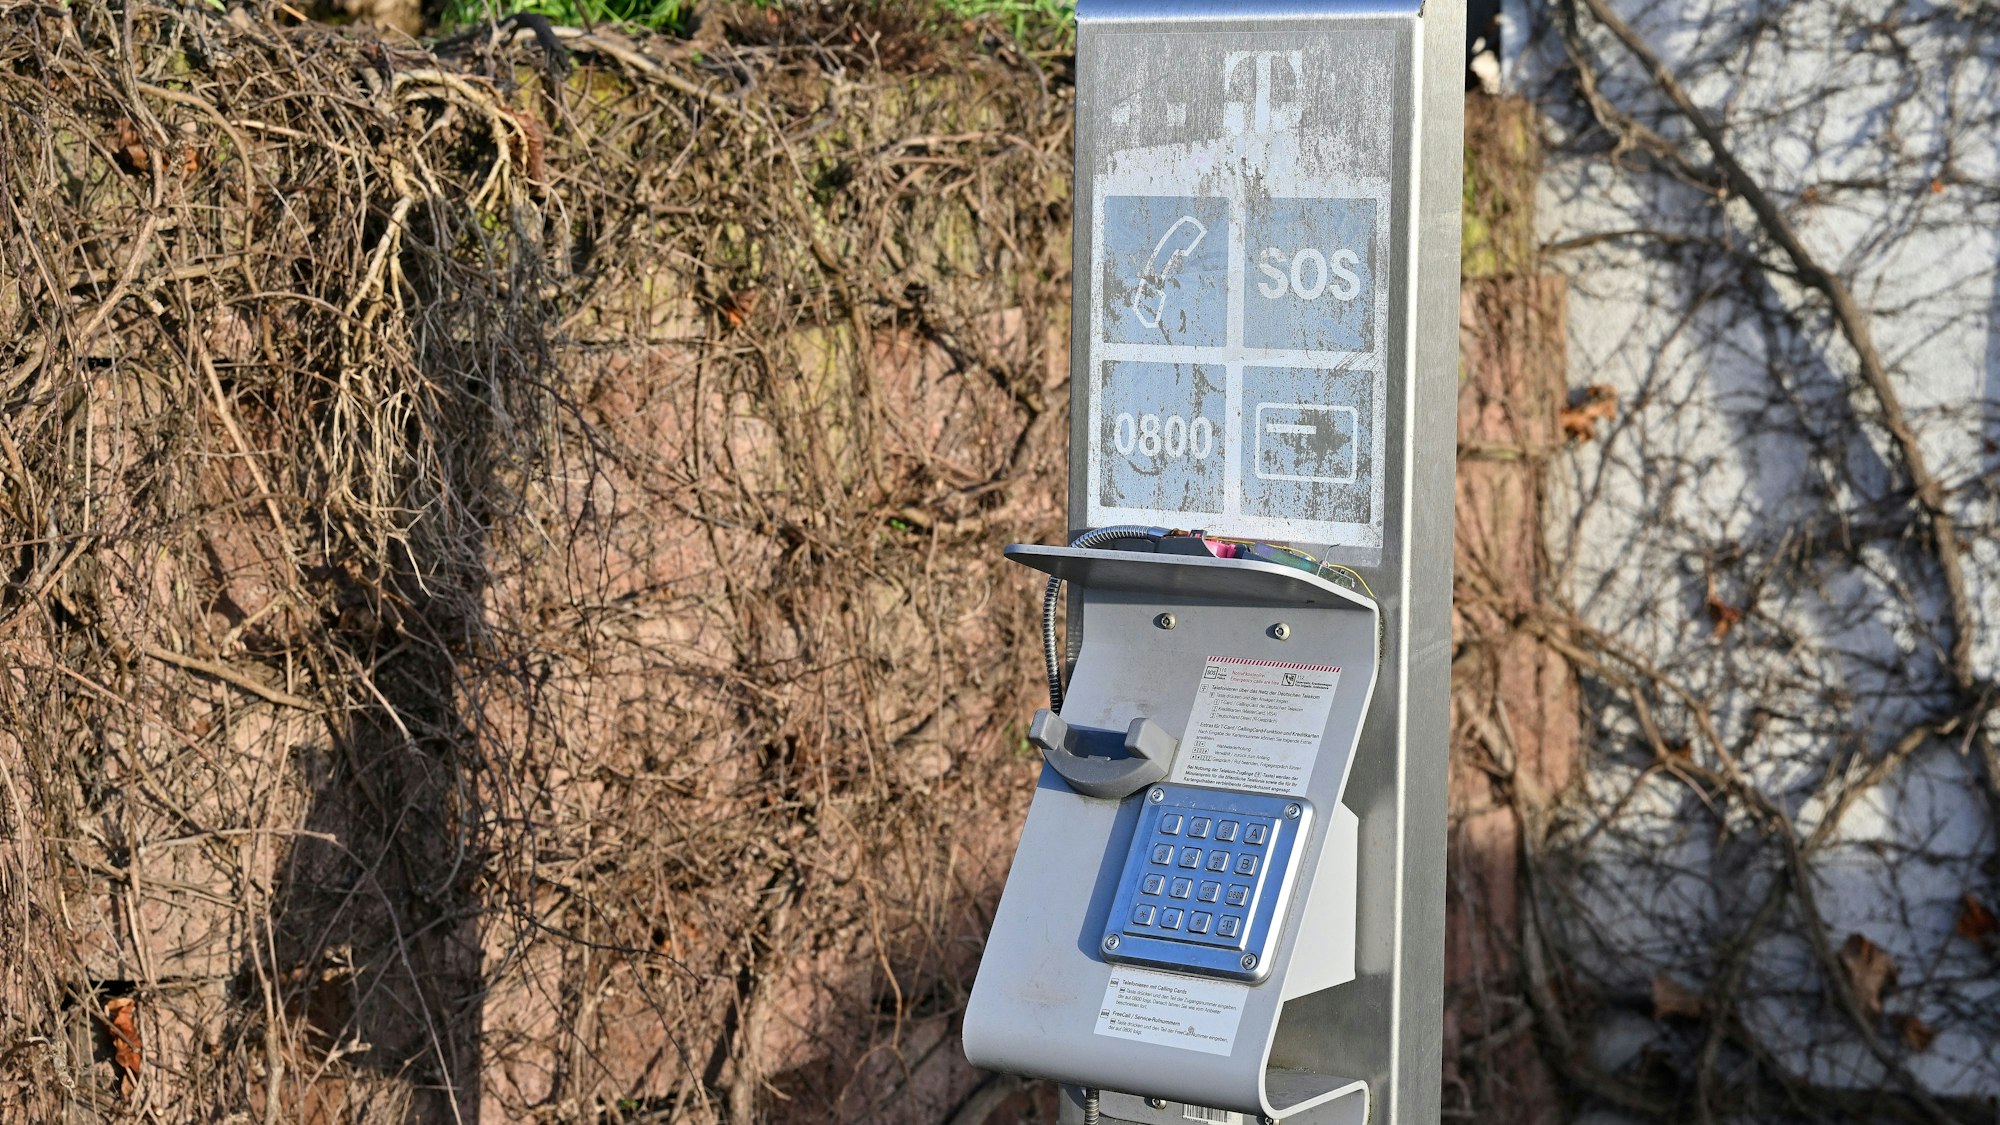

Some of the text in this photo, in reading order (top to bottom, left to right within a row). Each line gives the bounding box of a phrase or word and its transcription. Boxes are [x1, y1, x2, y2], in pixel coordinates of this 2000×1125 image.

[1257, 247, 1361, 301] SOS
[1113, 411, 1213, 460] 0800
[1249, 828, 1258, 840] A
[1241, 858, 1250, 870] B
[1122, 979, 1149, 988] Telefonieren
